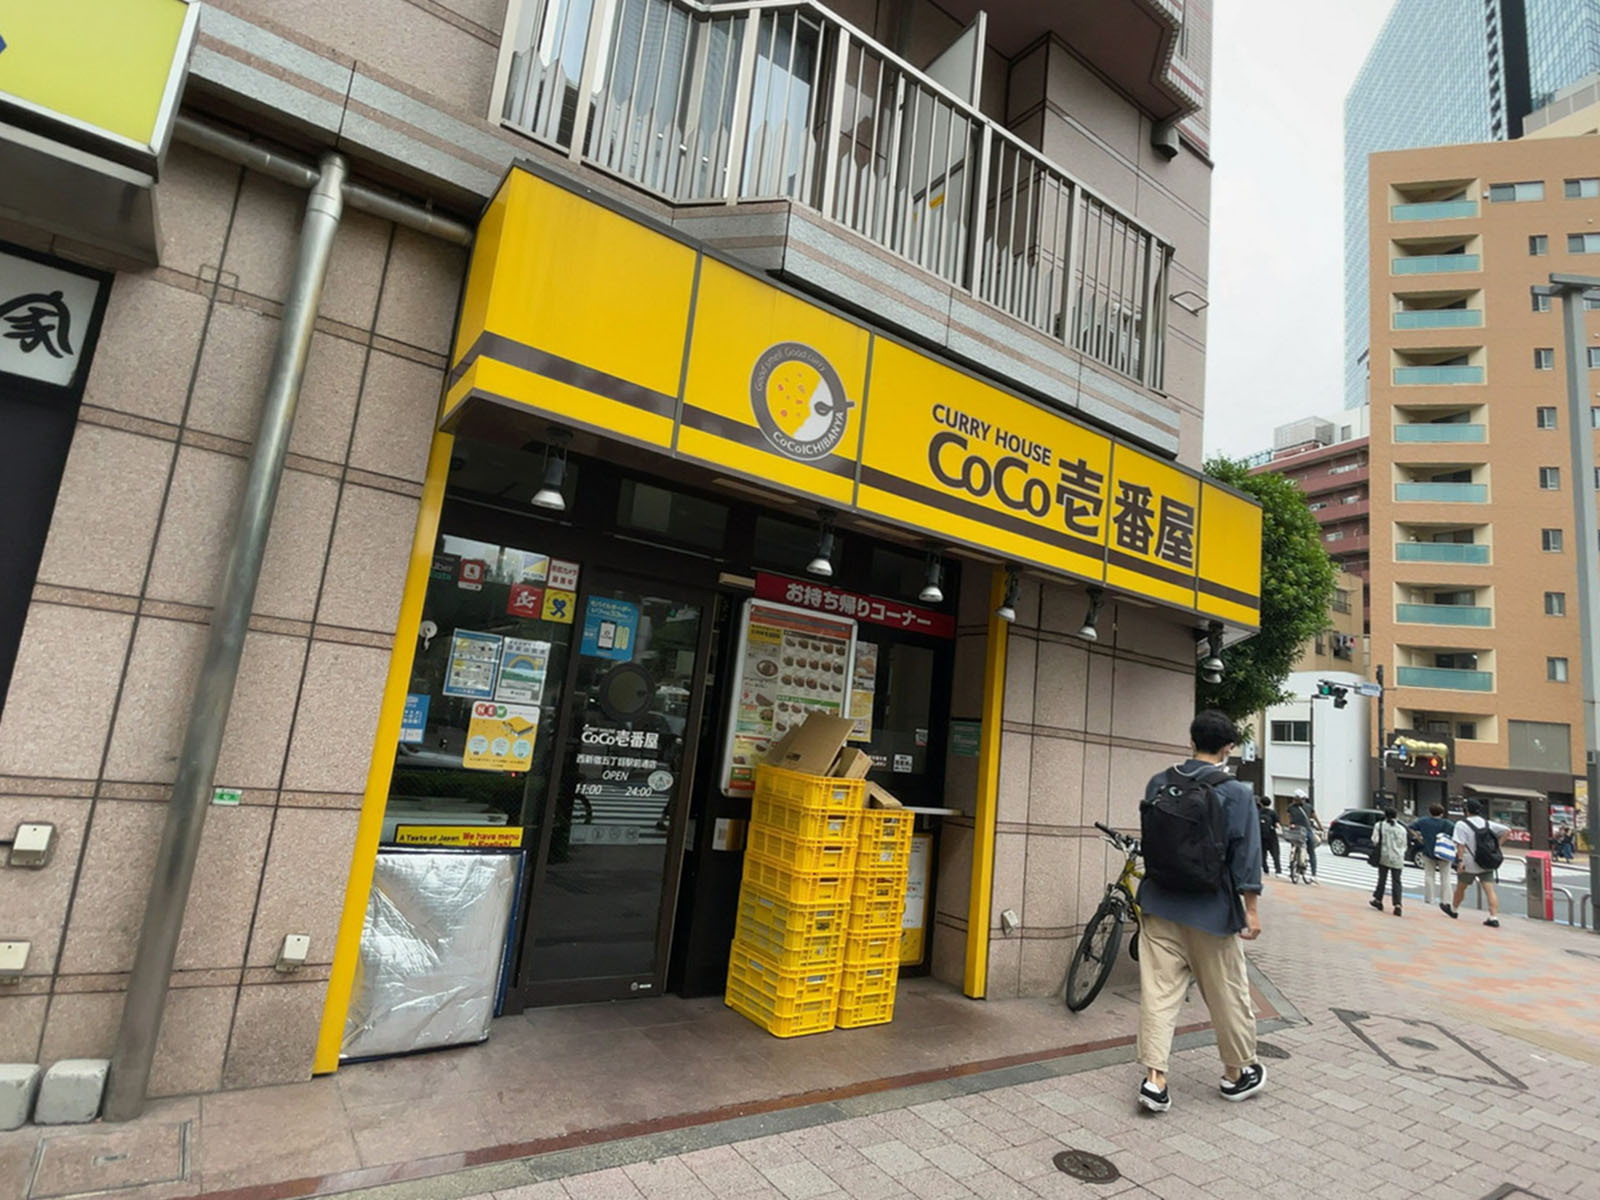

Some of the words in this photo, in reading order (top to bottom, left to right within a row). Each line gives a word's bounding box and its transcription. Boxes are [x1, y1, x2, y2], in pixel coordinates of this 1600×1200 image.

[931, 403, 992, 441] CURRY
[994, 428, 1052, 467] HOUSE
[785, 583, 931, 627] お持ち帰りコーナー
[602, 770, 629, 781] OPEN
[575, 784, 602, 795] 11:00
[463, 832, 474, 840] We
[476, 832, 496, 840] have
